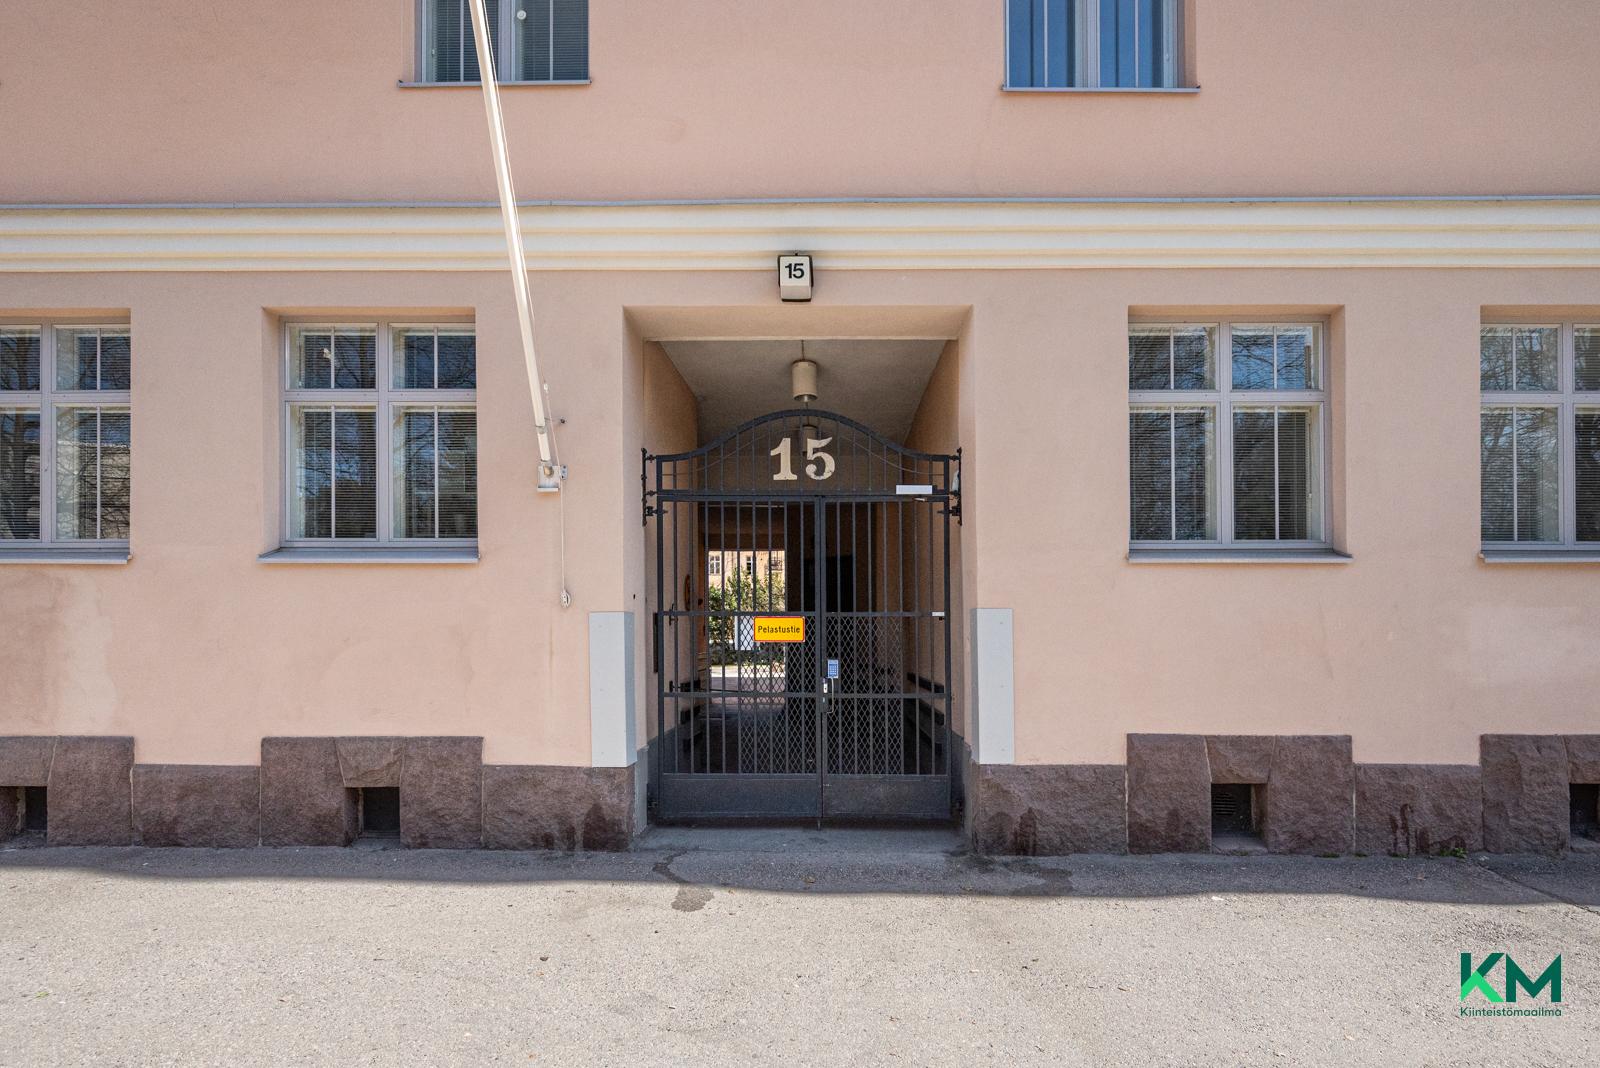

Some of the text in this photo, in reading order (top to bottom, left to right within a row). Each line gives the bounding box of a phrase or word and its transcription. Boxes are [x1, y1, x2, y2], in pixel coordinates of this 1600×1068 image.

[784, 262, 805, 279] 15
[770, 437, 836, 480] 15
[757, 625, 801, 634] Pelastustie
